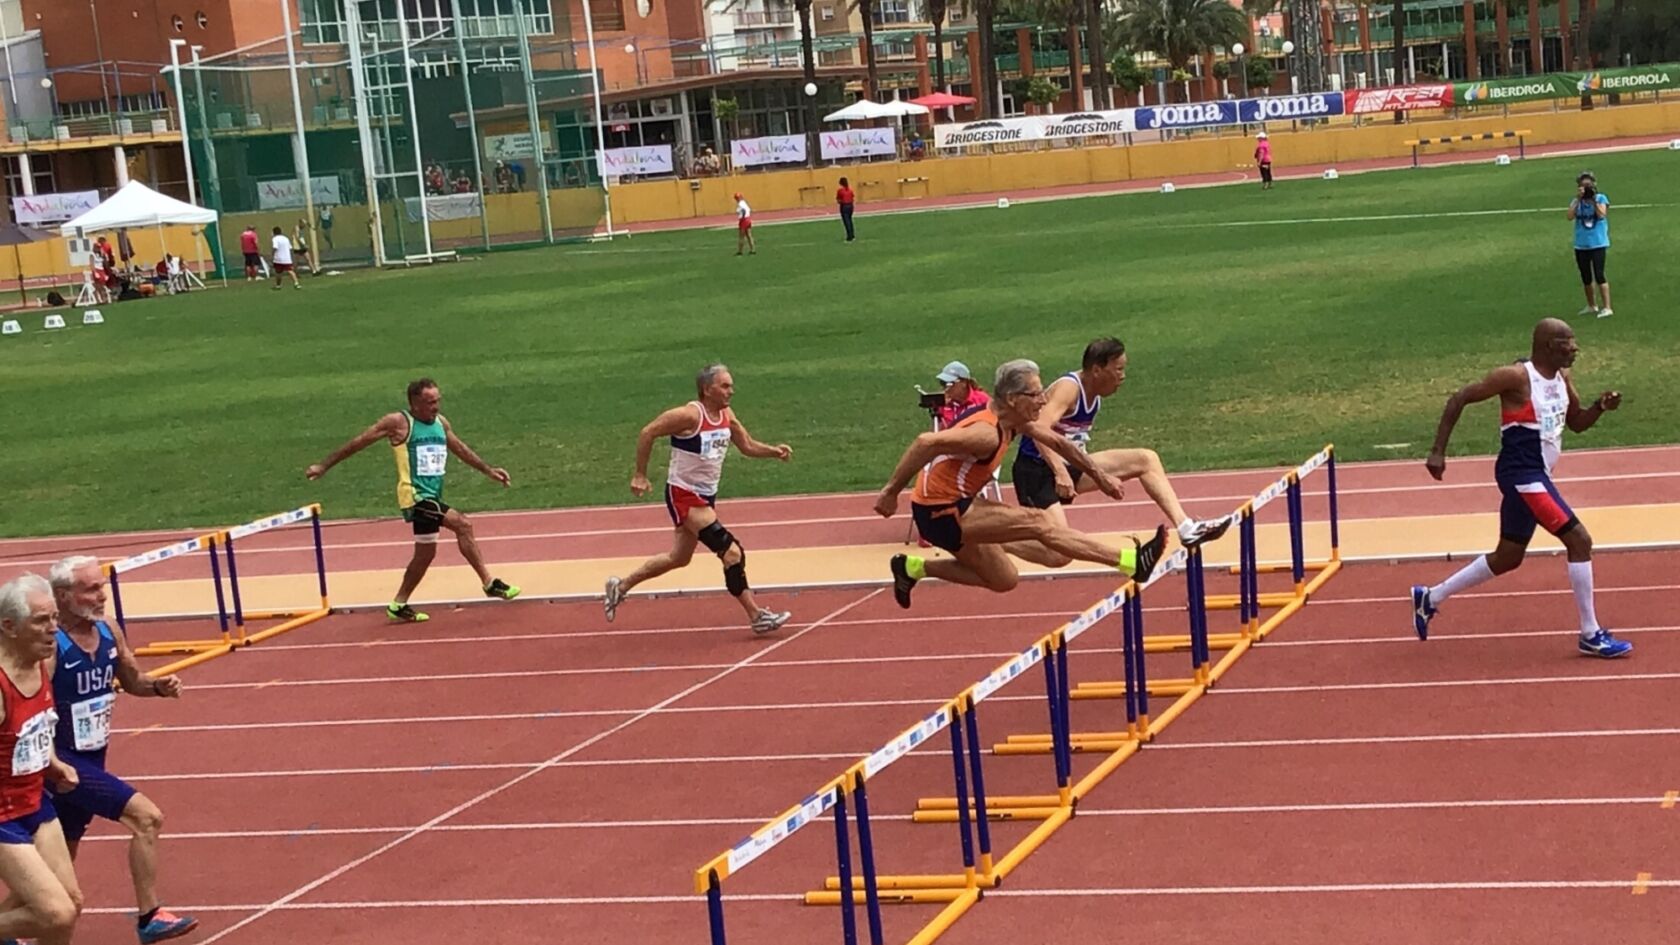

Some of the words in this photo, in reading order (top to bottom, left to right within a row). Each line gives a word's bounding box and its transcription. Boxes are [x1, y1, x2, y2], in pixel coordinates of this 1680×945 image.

[1602, 73, 1670, 88] IBERDROLA
[1489, 83, 1555, 98] IBERDROLA
[944, 128, 1023, 145] BRIDGESTONE
[1044, 120, 1124, 137] BRIDGESTONE
[76, 664, 114, 695] USA
